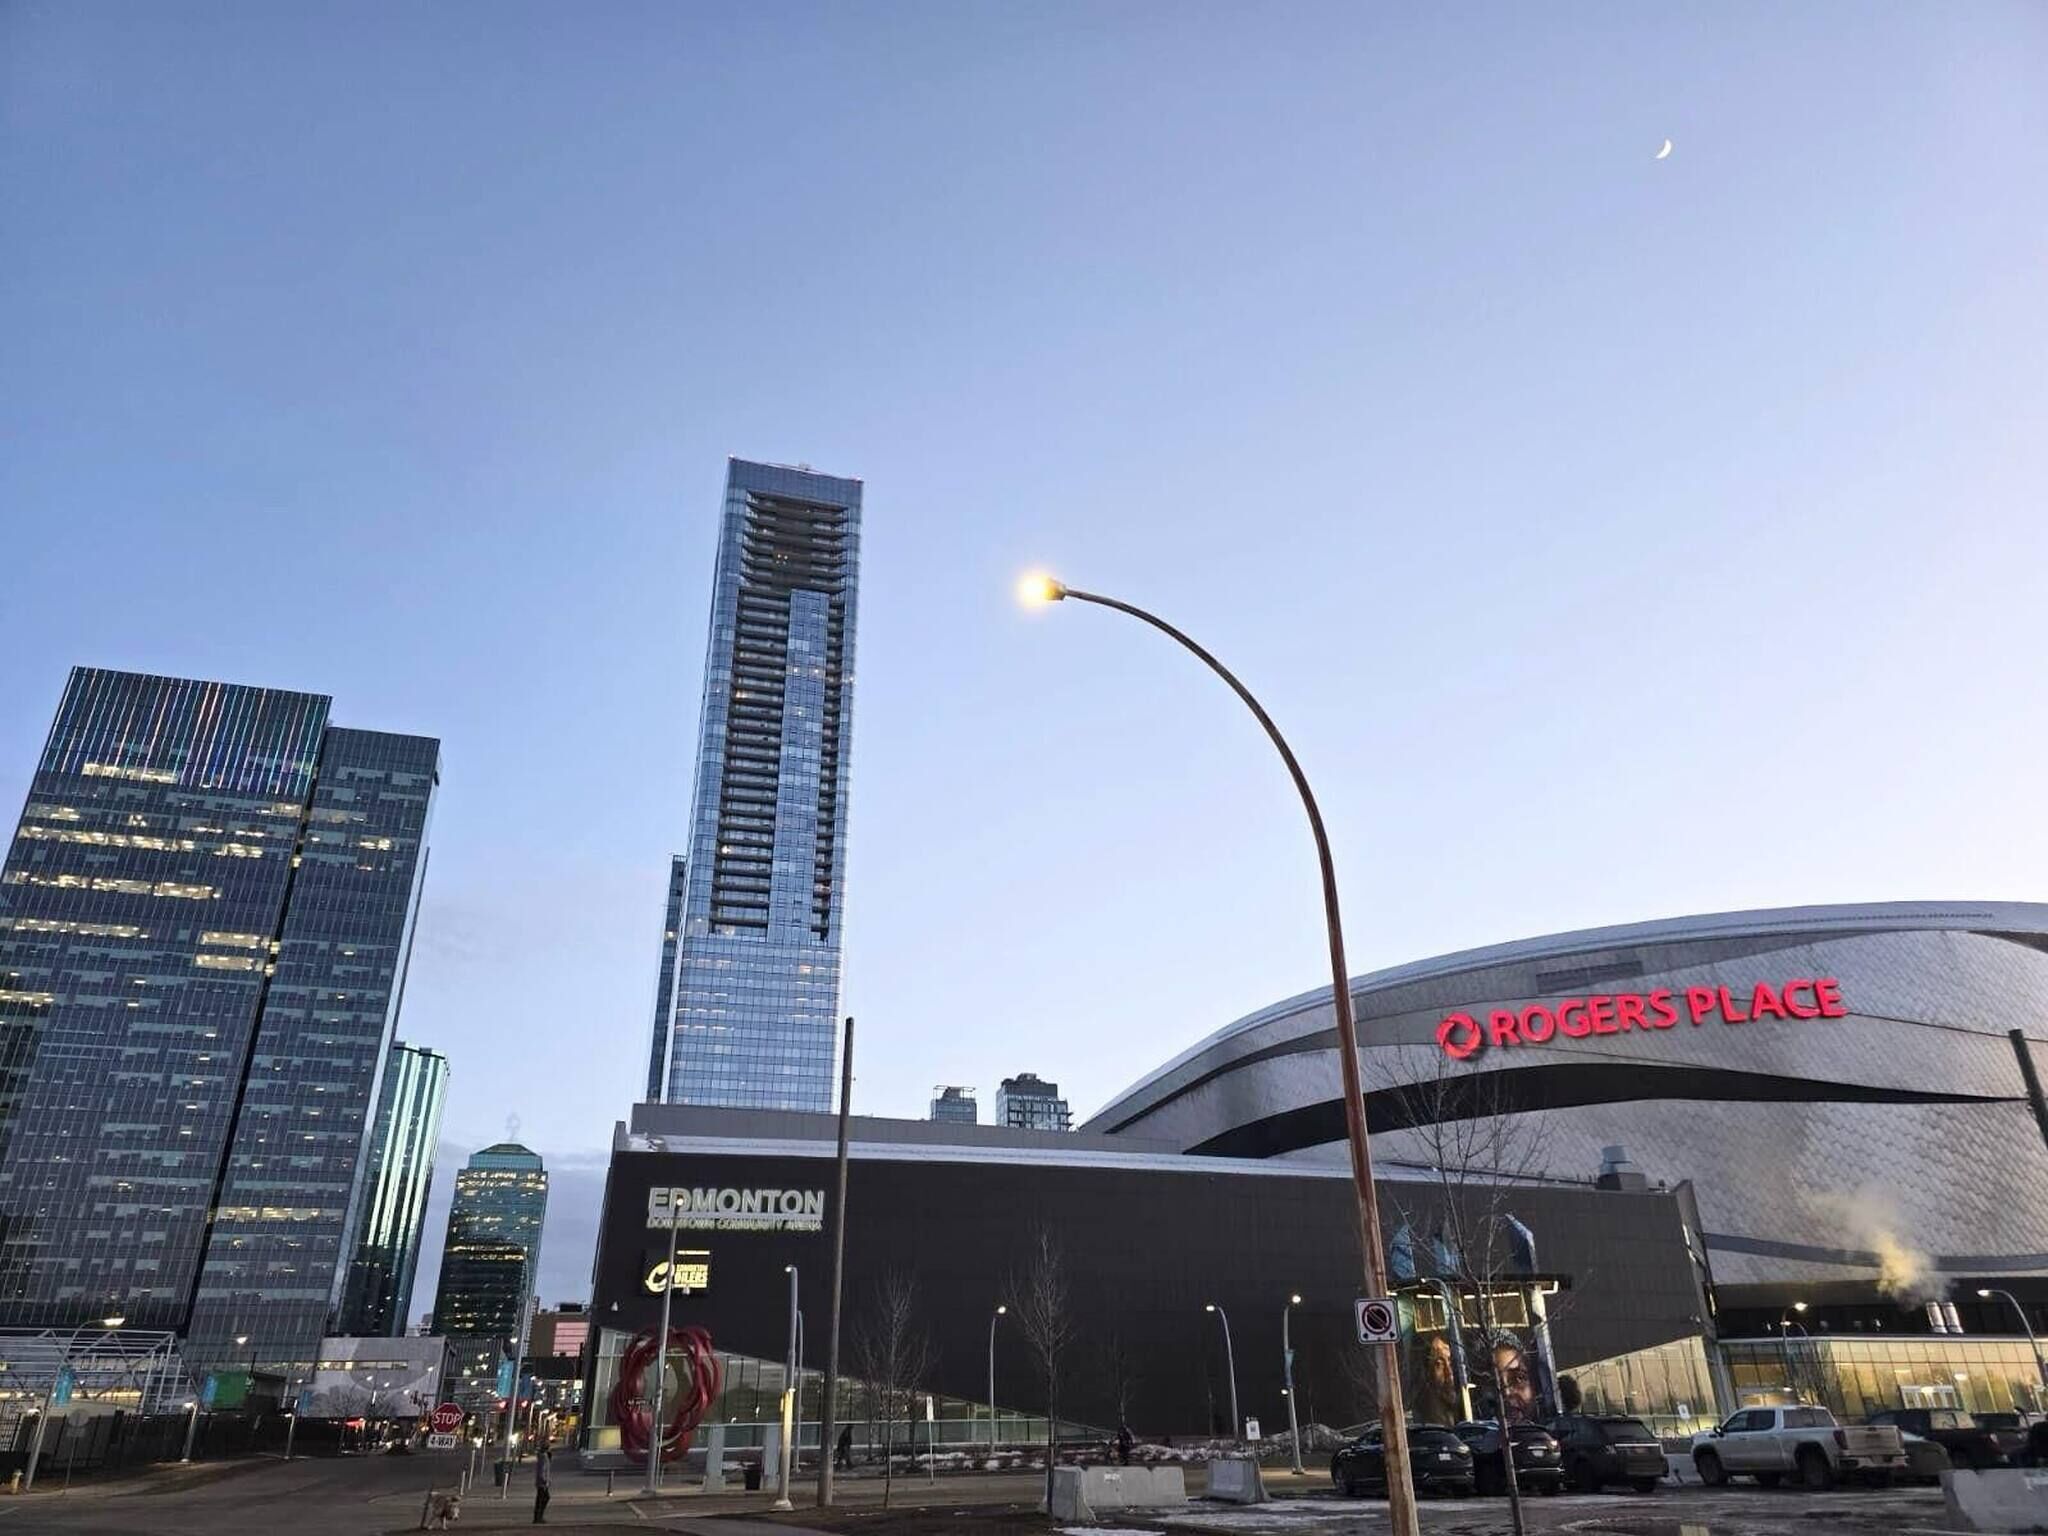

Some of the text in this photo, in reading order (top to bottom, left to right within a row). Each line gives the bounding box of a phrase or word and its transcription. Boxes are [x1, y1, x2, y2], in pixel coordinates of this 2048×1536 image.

[1489, 979, 1847, 1047] ROGERS PLACE
[648, 1187, 825, 1216] EDMONTON
[433, 1412, 461, 1425] STOP
